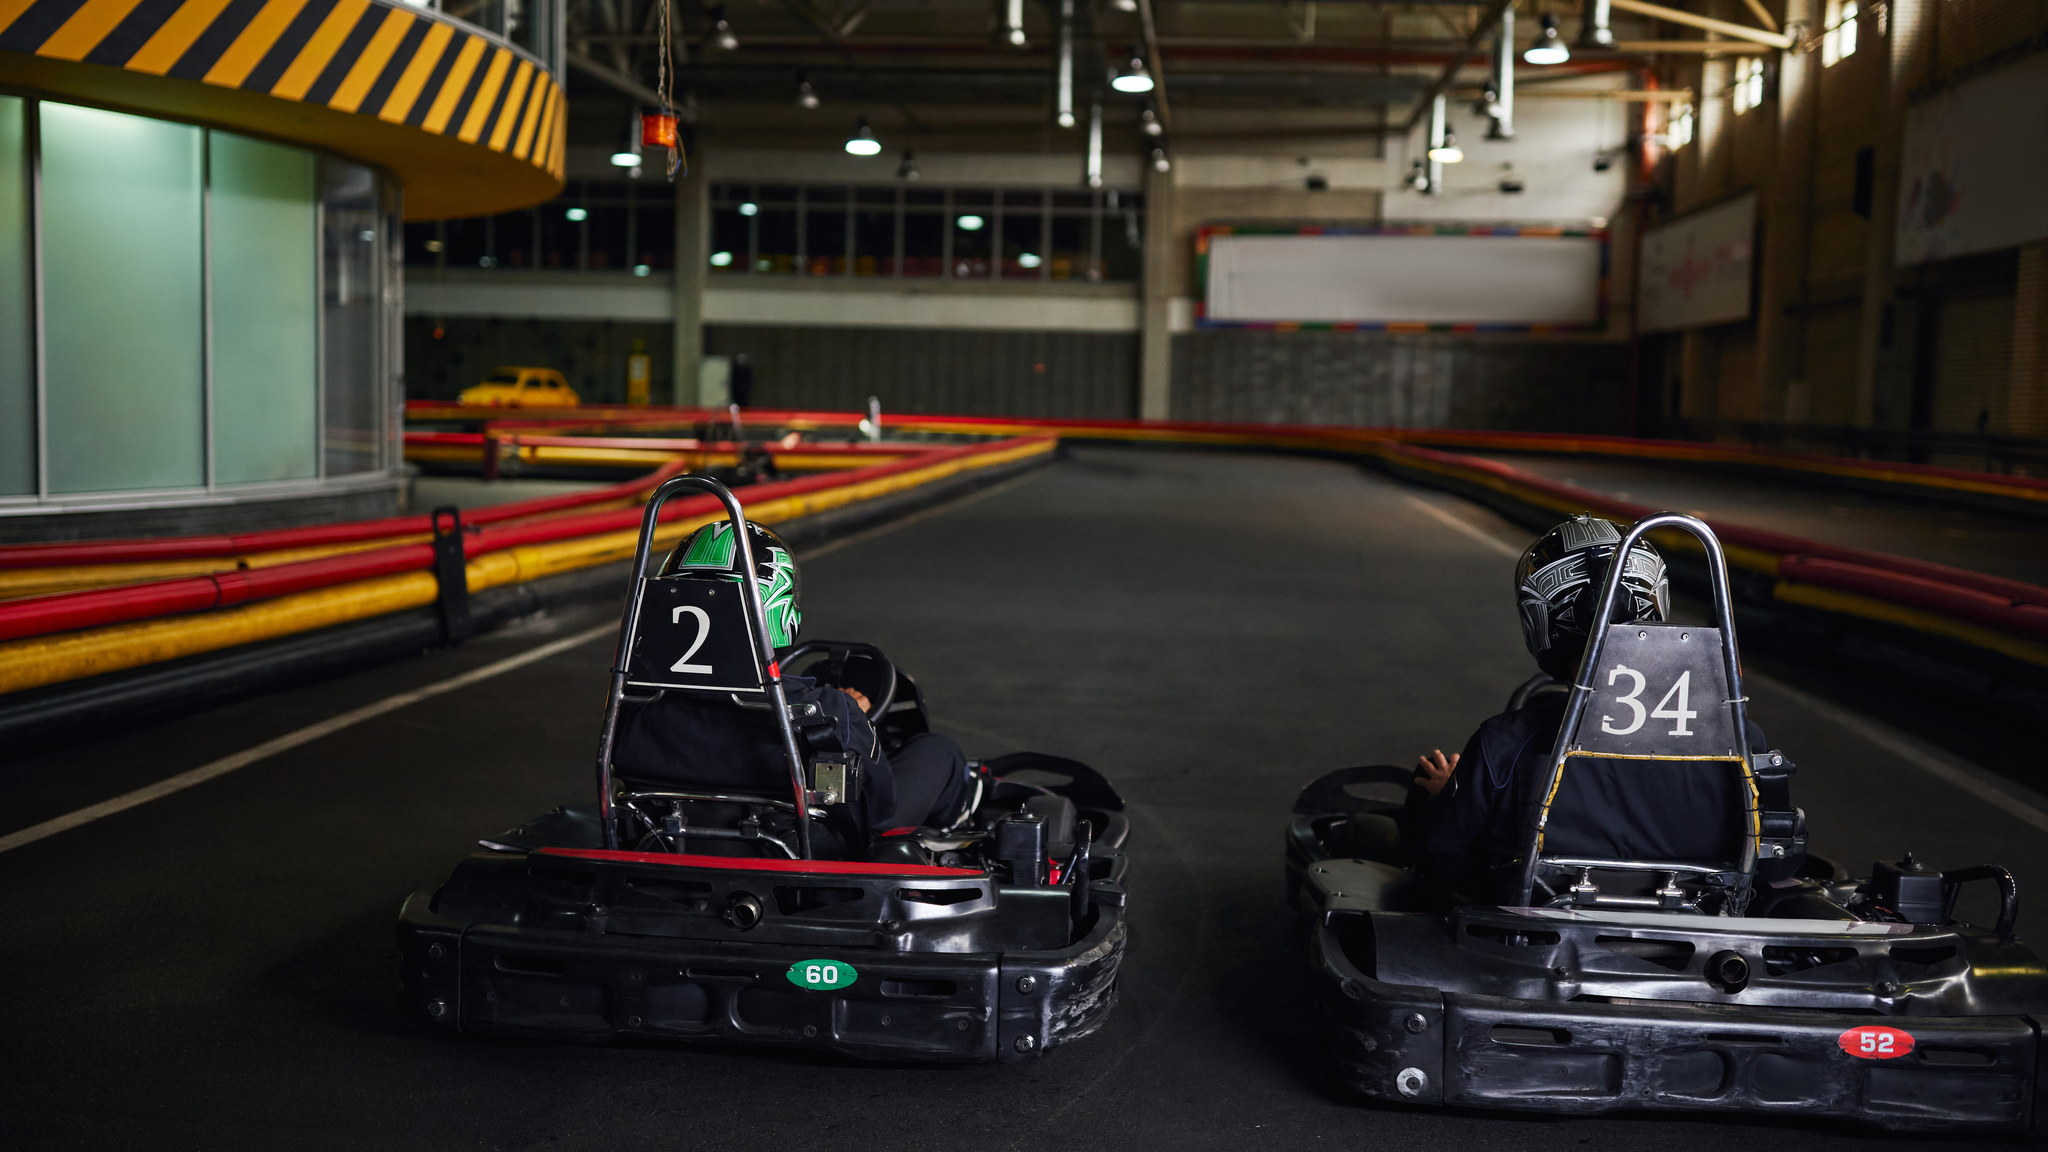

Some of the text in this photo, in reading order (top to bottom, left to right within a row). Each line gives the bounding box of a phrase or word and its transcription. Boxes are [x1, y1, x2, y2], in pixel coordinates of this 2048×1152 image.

[669, 605, 713, 675] 2
[1601, 664, 1698, 737] 34
[806, 965, 838, 984] 60
[1860, 1032, 1895, 1053] 52
